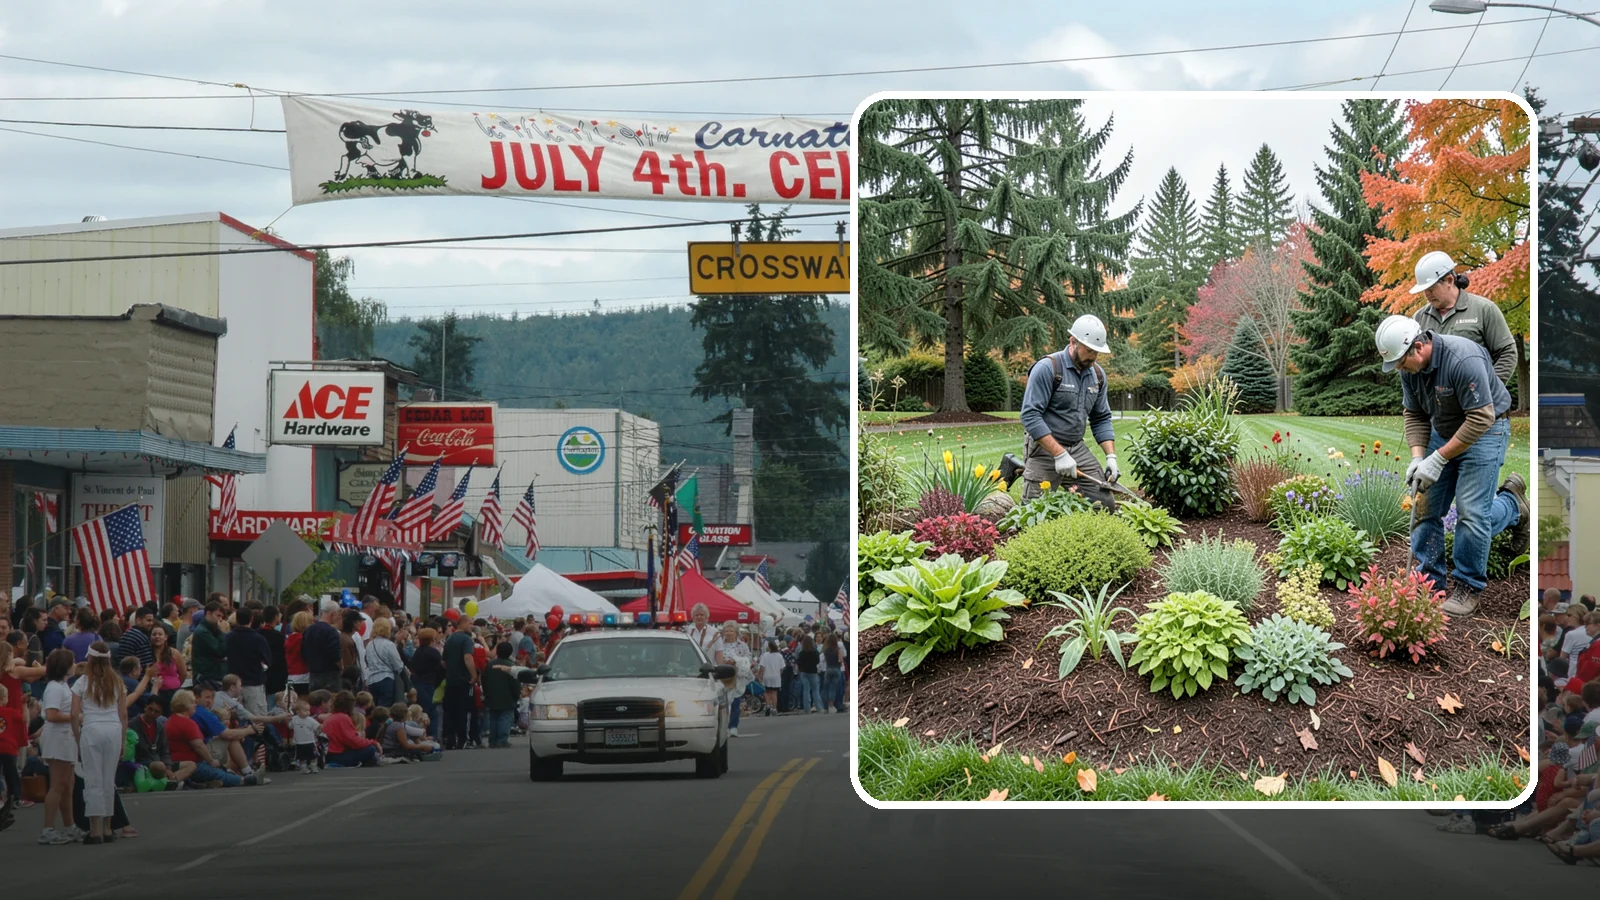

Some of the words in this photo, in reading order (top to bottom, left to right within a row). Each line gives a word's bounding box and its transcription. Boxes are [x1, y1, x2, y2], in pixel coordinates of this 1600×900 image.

[695, 121, 849, 149] Carnat
[481, 141, 605, 192] JULY
[632, 150, 746, 198] 4th.
[697, 254, 849, 280] CROSSWA
[283, 380, 374, 420] ACE
[405, 409, 452, 422] CEDAR
[283, 421, 371, 437] Hardware
[416, 428, 477, 447] Coca-Cola
[354, 467, 386, 480] Simpl
[83, 484, 94, 494] St.
[95, 484, 124, 494] Vincent
[126, 485, 136, 495] de
[137, 485, 155, 495] Paul
[688, 526, 741, 535] CRNATION
[699, 535, 730, 543] GLASS
